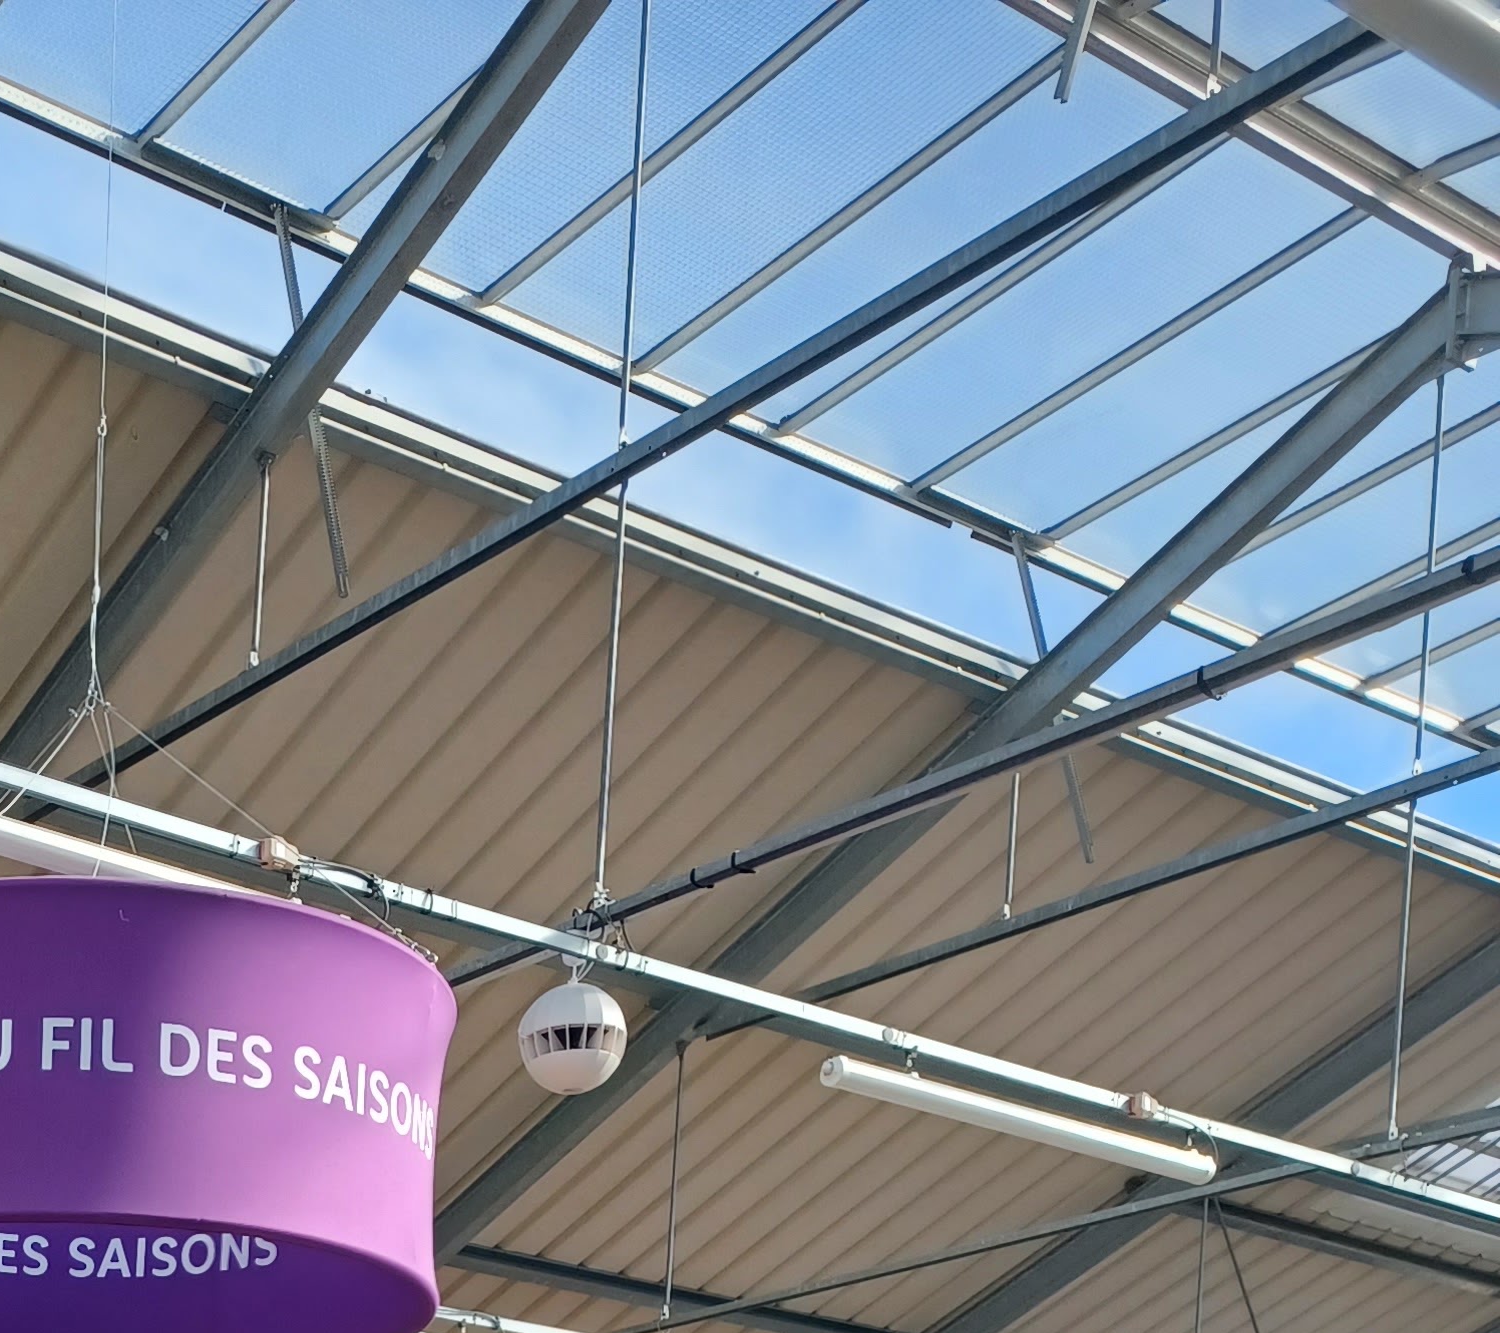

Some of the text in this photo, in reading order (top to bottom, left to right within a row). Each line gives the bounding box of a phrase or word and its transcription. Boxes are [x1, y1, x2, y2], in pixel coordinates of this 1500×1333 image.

[41, 1017, 134, 1073] FIL
[159, 1022, 275, 1090] DES
[294, 1045, 436, 1162] SAISONS
